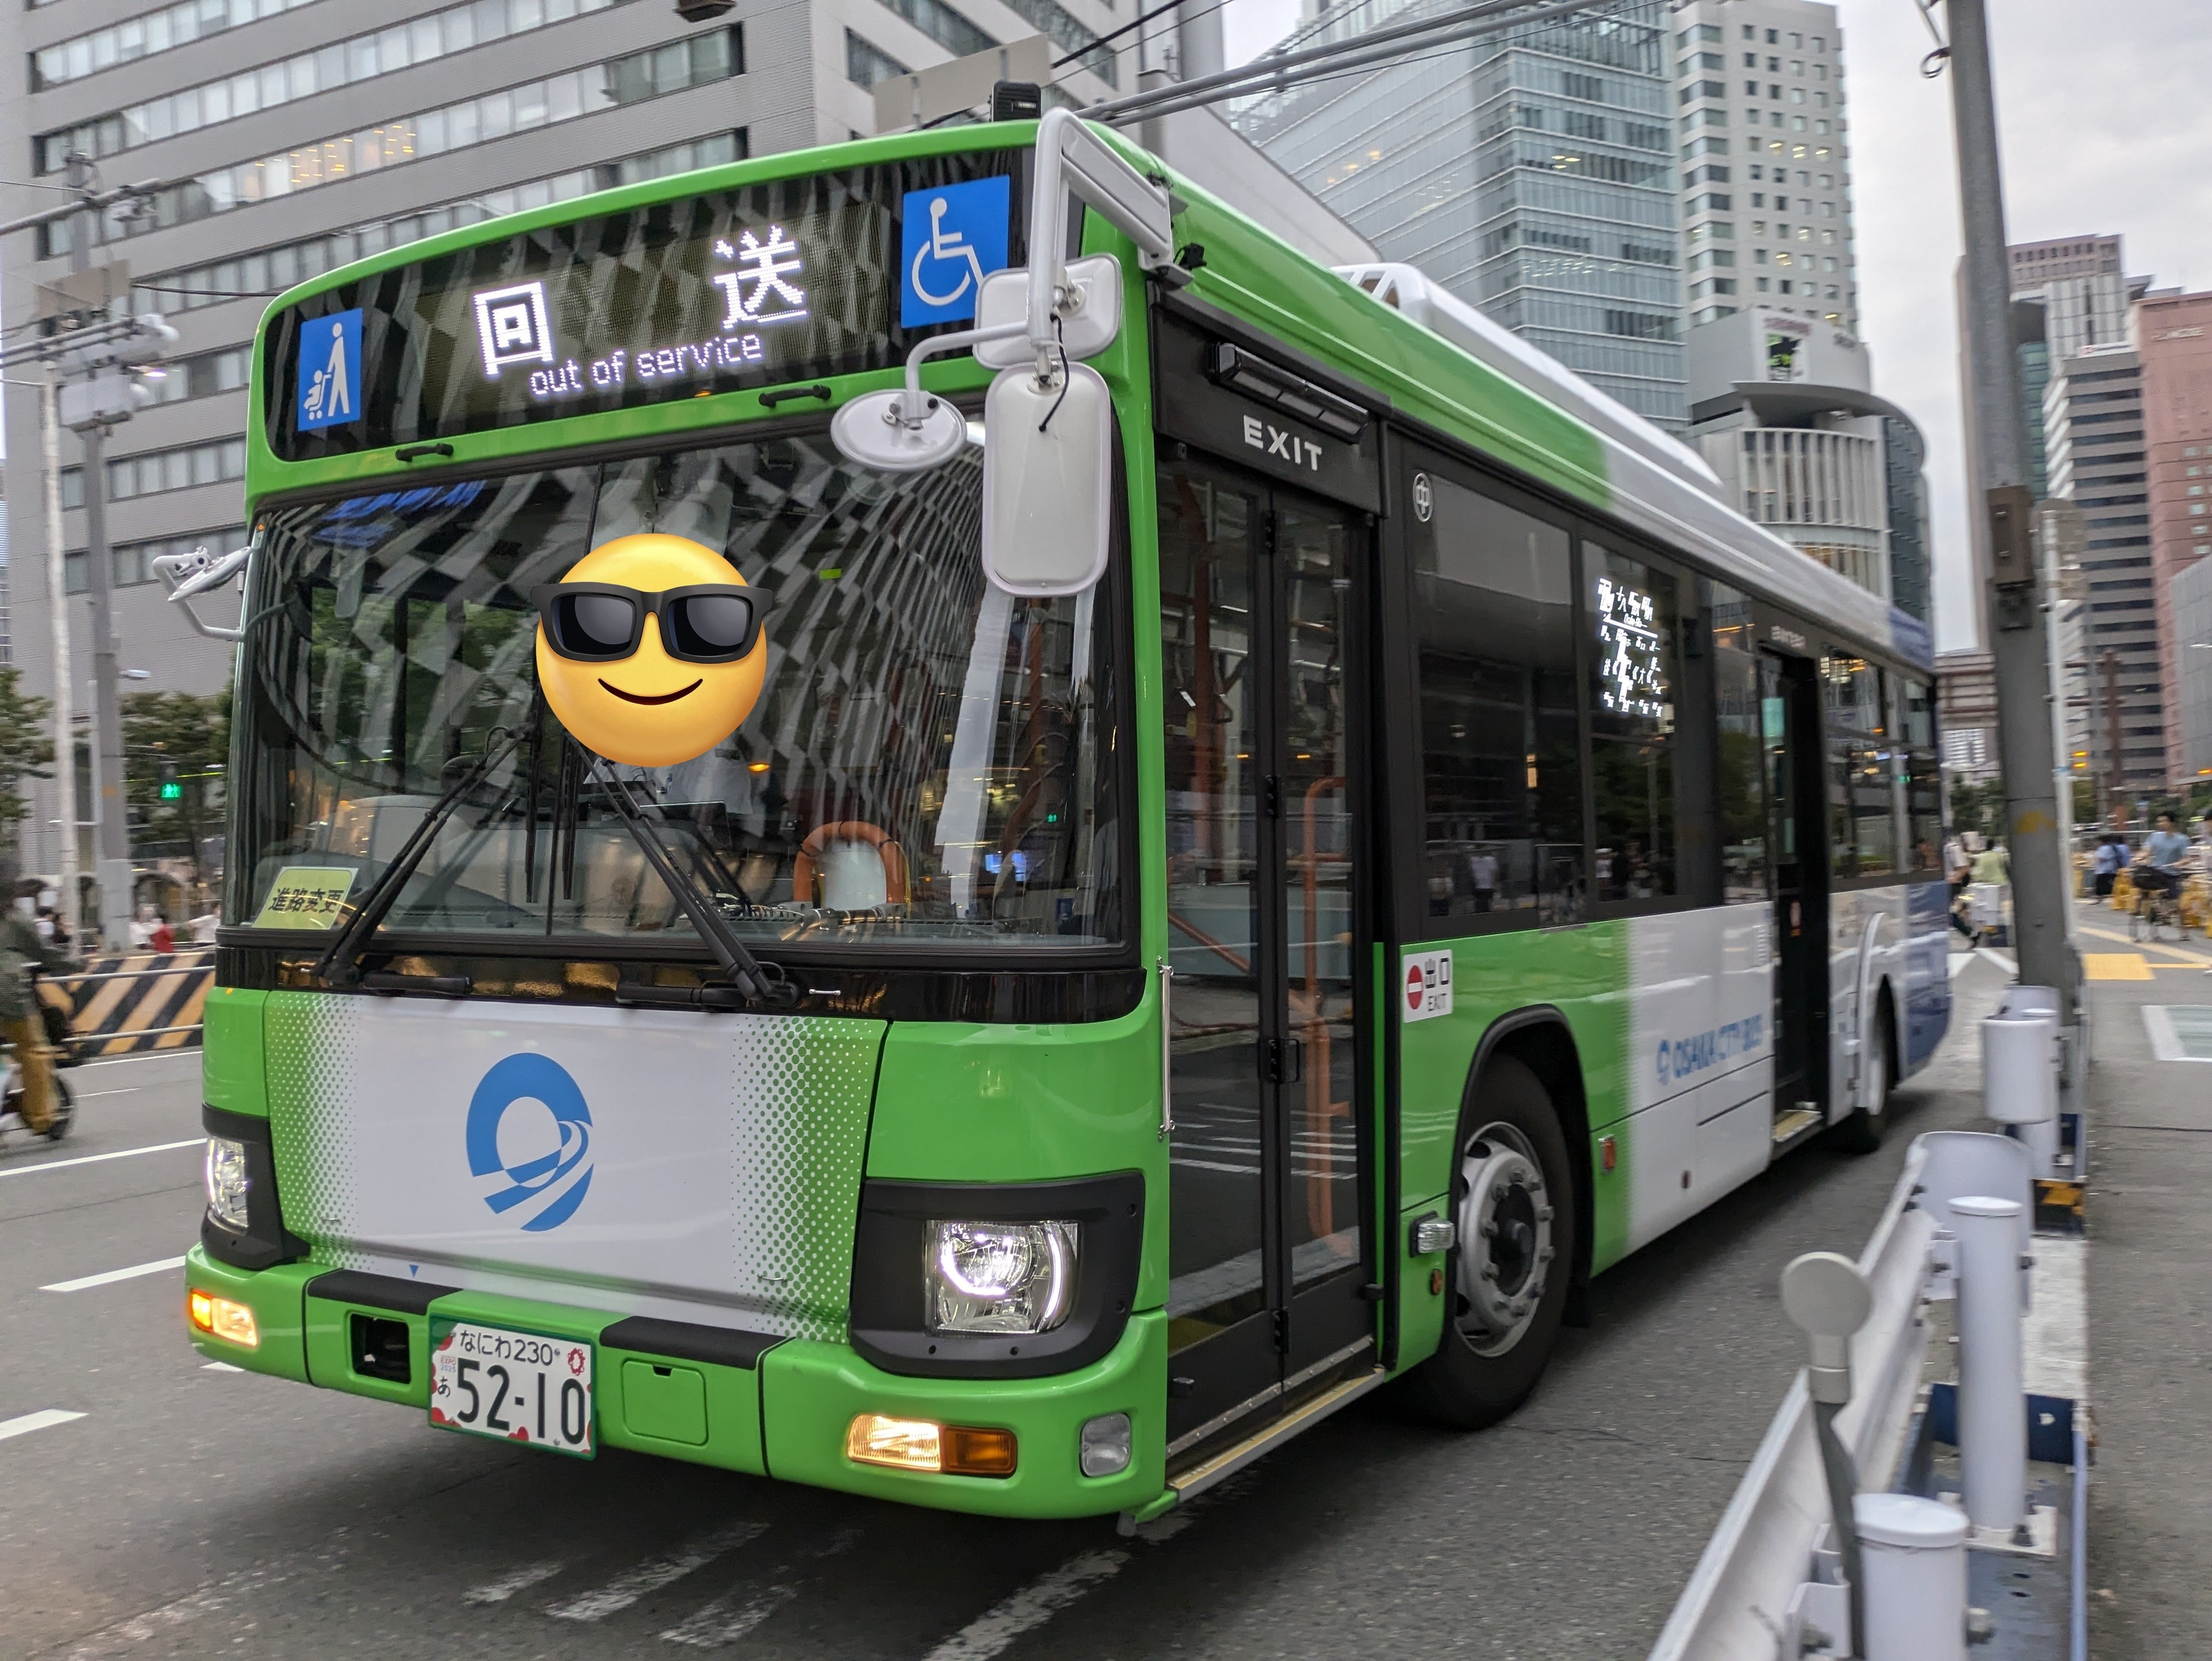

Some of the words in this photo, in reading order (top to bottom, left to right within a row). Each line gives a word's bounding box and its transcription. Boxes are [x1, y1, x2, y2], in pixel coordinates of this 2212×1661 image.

[530, 360, 582, 396] out
[592, 350, 626, 385] of
[636, 334, 763, 378] service
[1243, 414, 1322, 471] EXIT
[268, 886, 344, 914] 進路変更
[1424, 957, 1451, 989] 出口
[440, 1357, 456, 1366] EXPO
[440, 1364, 456, 1373] 2025
[437, 1376, 451, 1397] あ
[457, 1357, 586, 1445] 52-10
